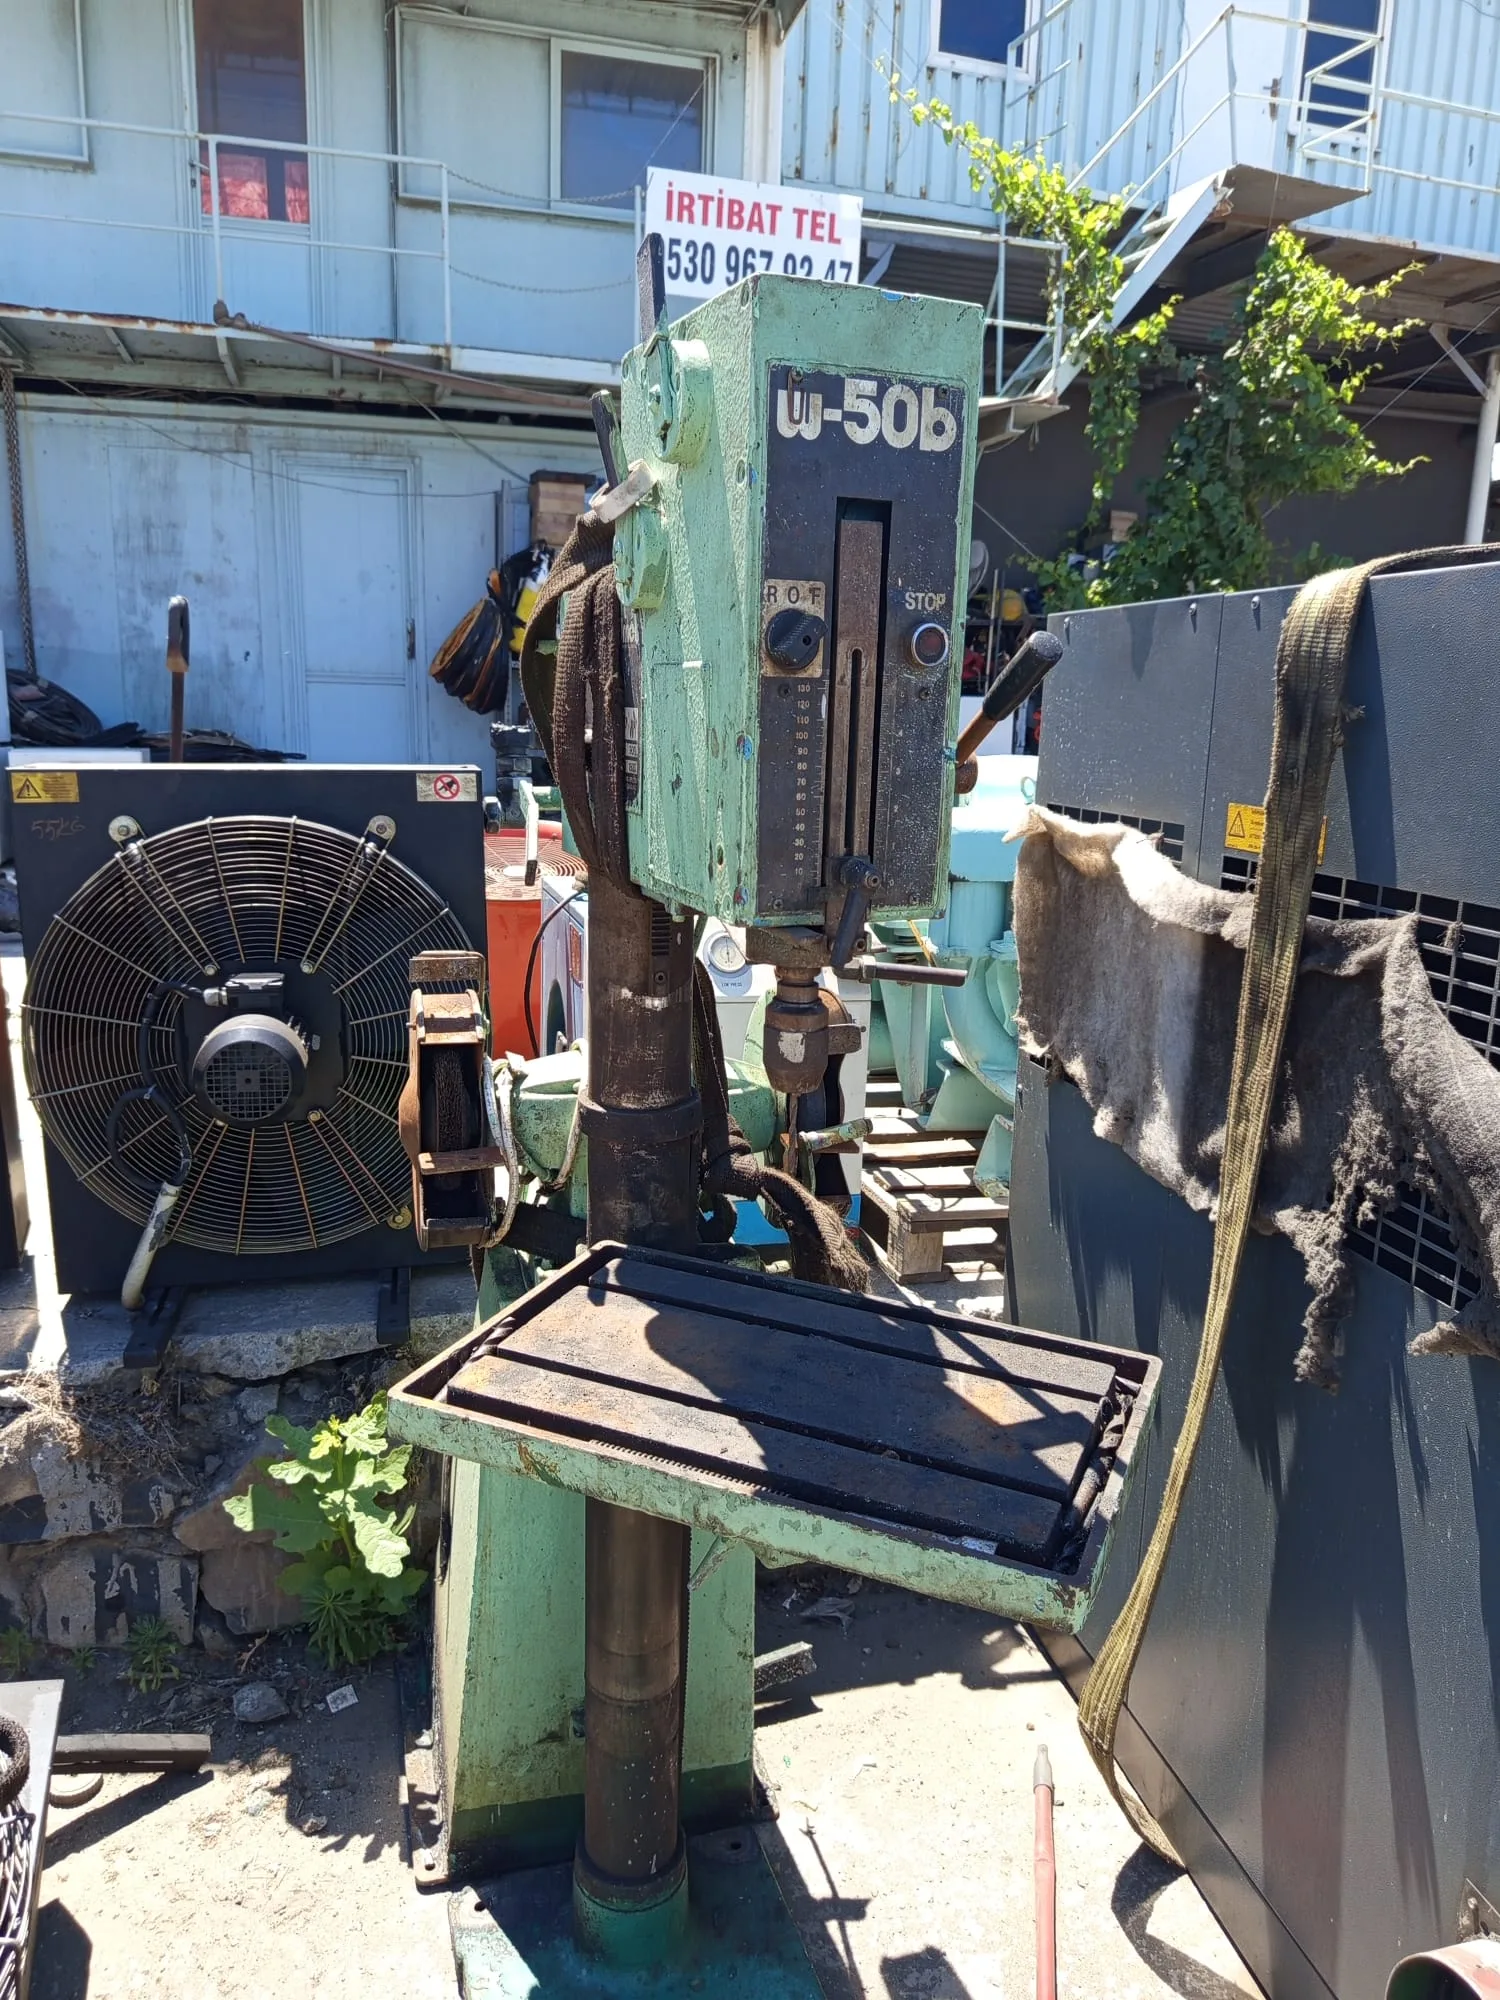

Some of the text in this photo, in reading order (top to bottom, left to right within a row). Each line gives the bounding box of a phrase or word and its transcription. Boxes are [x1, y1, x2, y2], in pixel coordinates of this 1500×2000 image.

[665, 181, 842, 245] İRTİBAT TEL
[767, 585, 777, 604] R
[808, 587, 821, 605] F
[904, 591, 947, 611] STOP
[797, 684, 811, 693] 130
[797, 700, 810, 709] 120
[797, 716, 810, 724] 110
[795, 732, 809, 740] 100
[797, 747, 809, 756] 90
[796, 762, 808, 770] 80
[796, 778, 807, 786] 70
[796, 793, 807, 801] 60
[795, 808, 806, 816] 50
[794, 823, 806, 832] 40
[794, 838, 805, 847] 30
[794, 853, 804, 861] 20
[795, 868, 804, 876] 10
